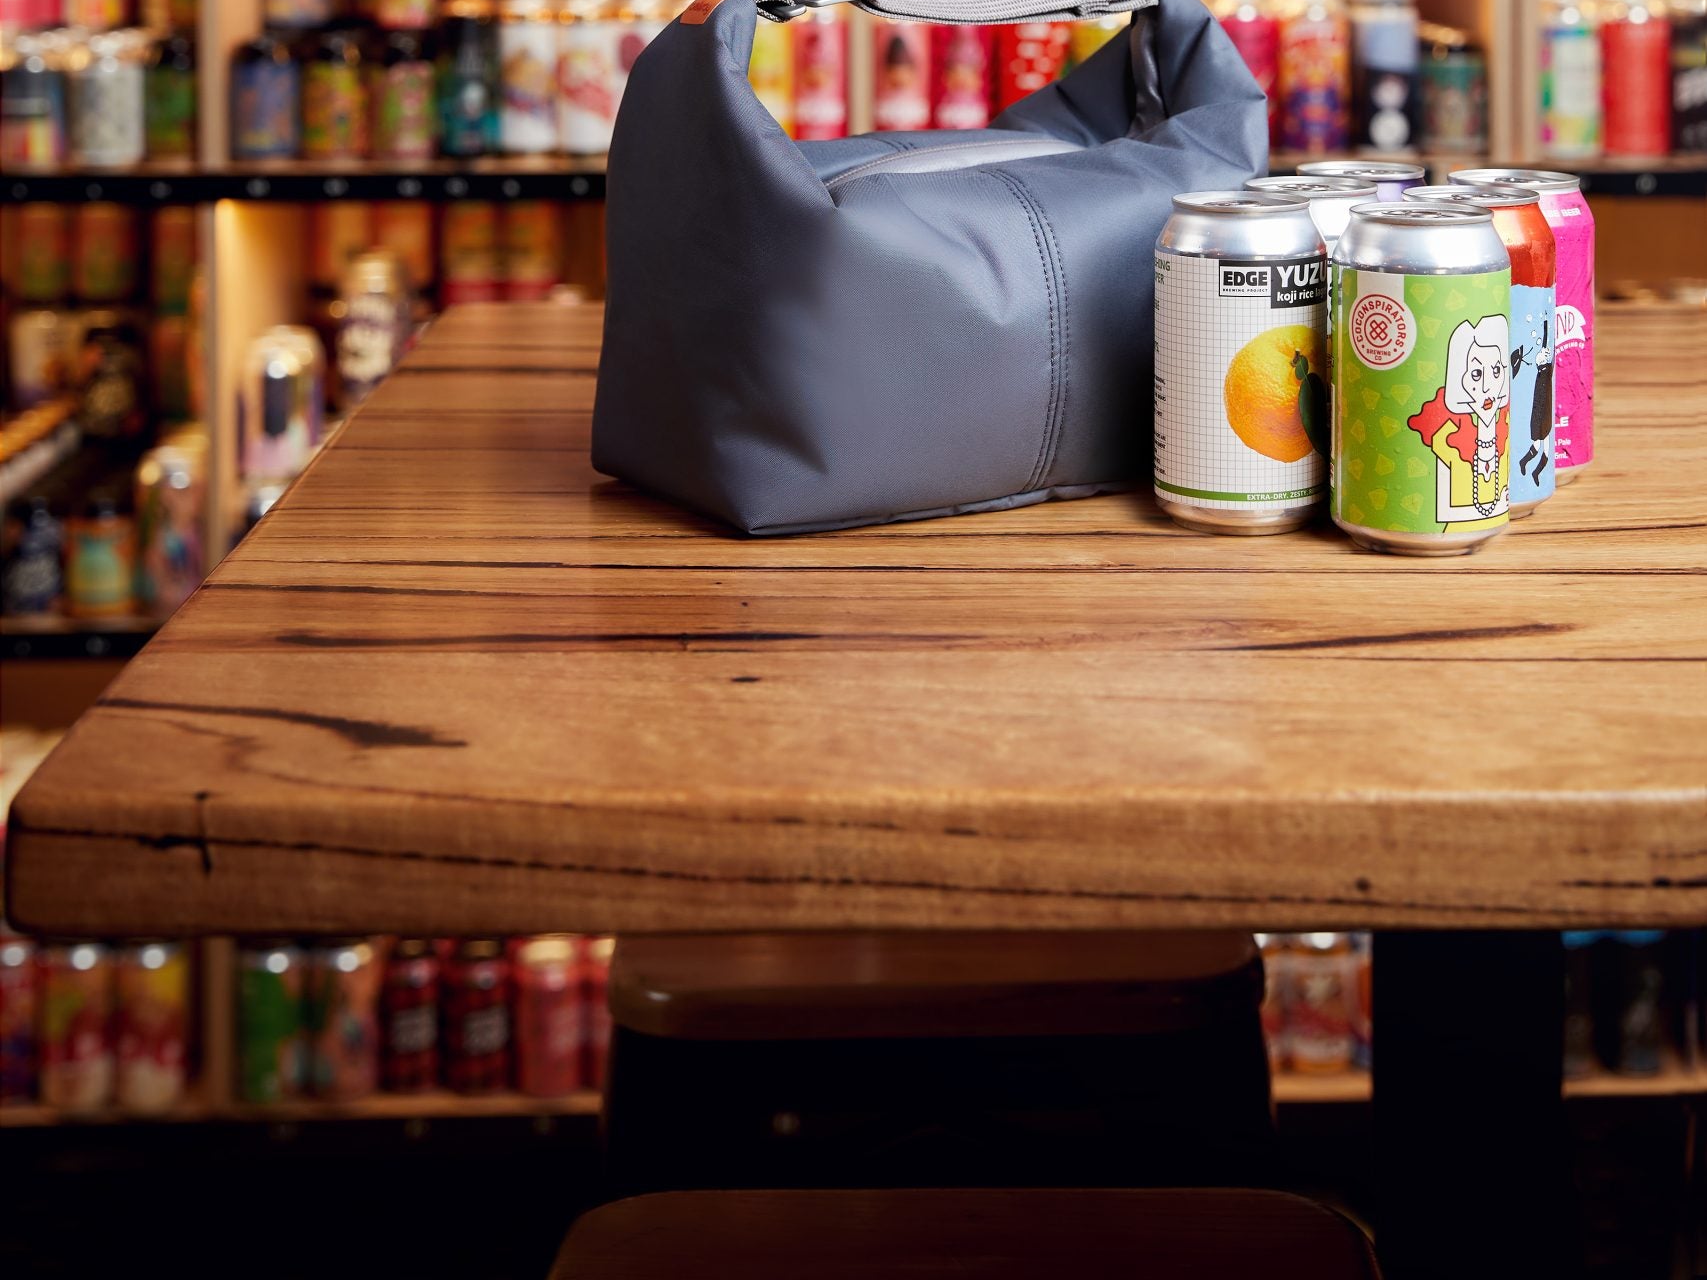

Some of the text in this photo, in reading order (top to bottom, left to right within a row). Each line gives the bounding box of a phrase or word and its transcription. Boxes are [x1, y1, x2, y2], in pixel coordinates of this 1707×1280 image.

[1223, 271, 1268, 287] EDGE
[1277, 259, 1327, 288] YUZU
[1277, 290, 1297, 304] koji
[1299, 289, 1314, 300] rice
[1355, 300, 1407, 348] COCONSPIRATORS
[1556, 311, 1575, 339] ND
[1366, 348, 1391, 357] BREWING
[1247, 492, 1289, 501] EXTRA-DRY.
